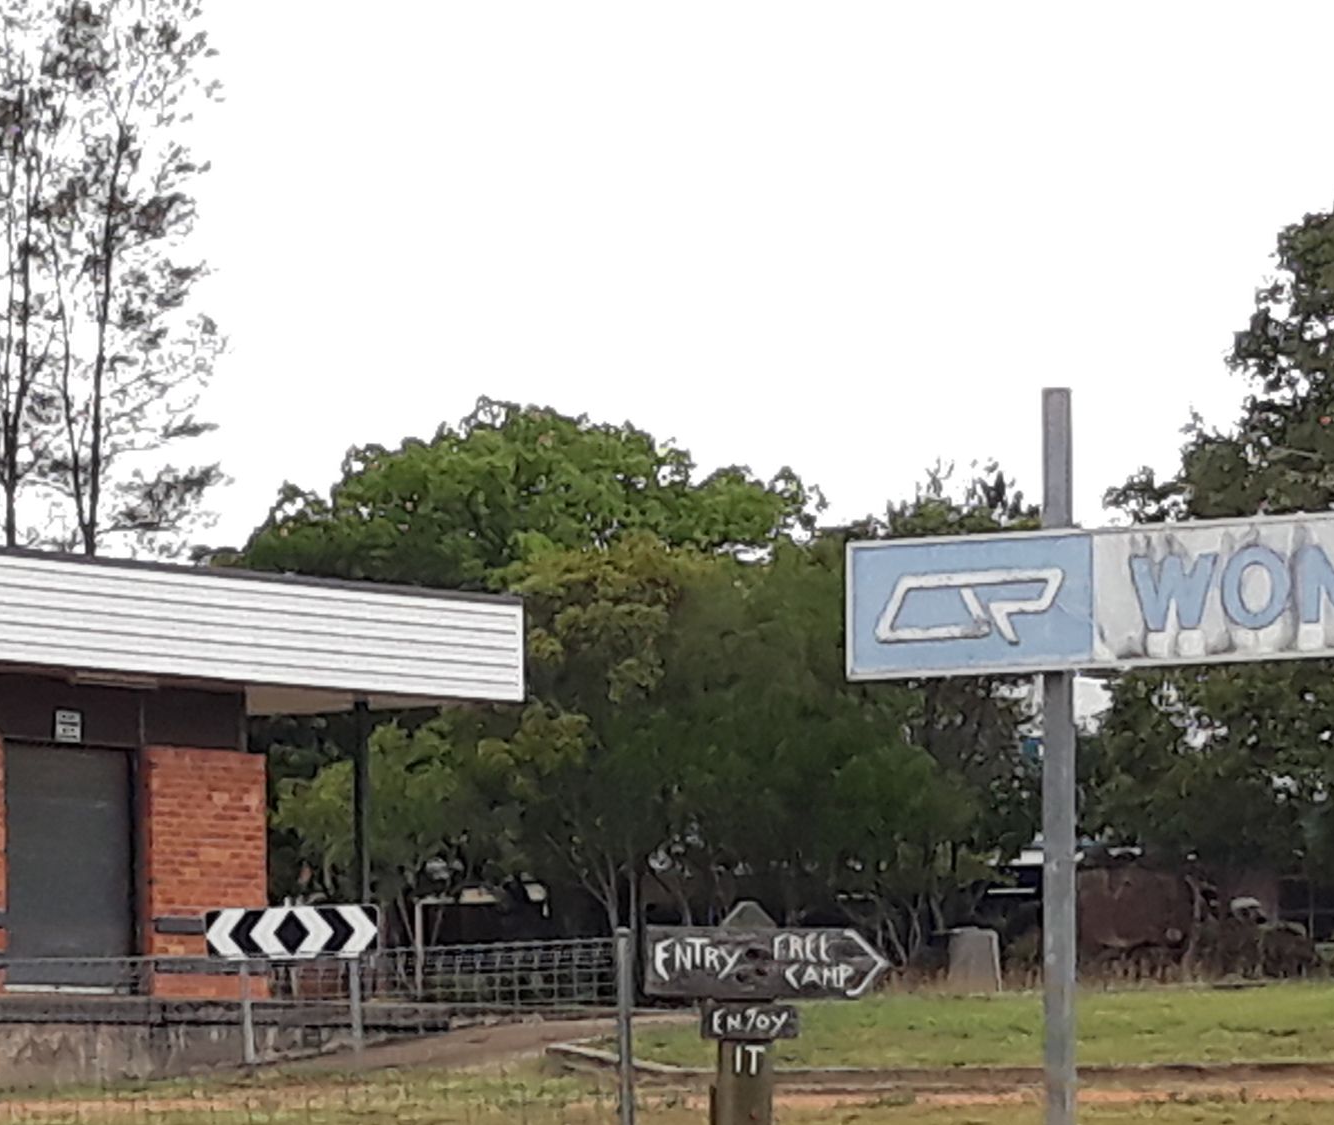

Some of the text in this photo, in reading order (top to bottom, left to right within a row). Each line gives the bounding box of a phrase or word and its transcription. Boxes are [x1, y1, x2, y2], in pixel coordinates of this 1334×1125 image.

[655, 937, 743, 980] ENTRY
[774, 933, 831, 963] FREE
[785, 963, 855, 989] CAMP
[711, 1007, 788, 1036] ENJOY
[735, 1044, 766, 1075] IT
